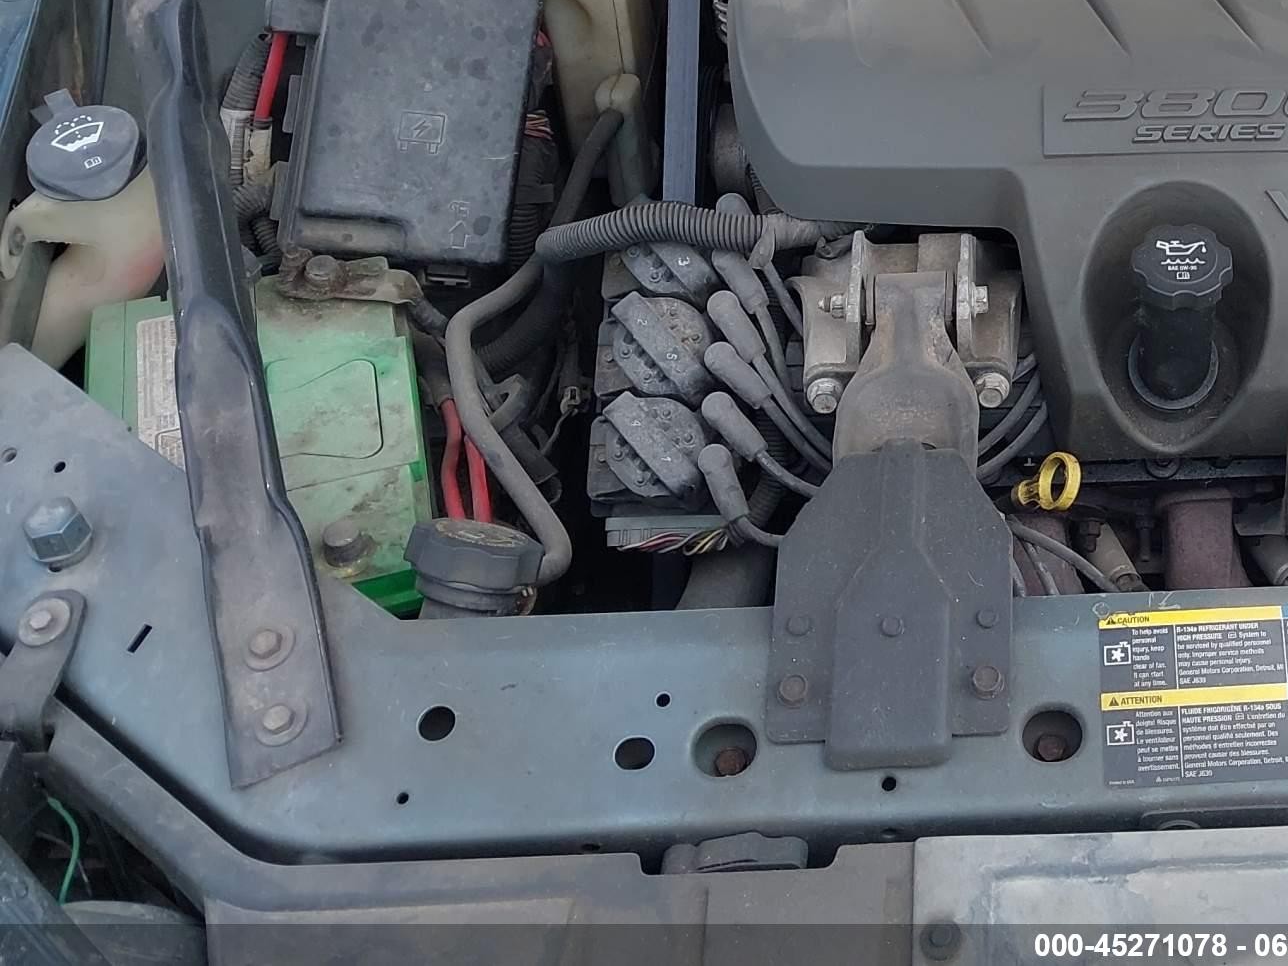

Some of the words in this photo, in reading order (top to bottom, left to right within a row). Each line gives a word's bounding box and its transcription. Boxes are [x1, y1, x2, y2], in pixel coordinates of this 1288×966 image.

[1132, 123, 1286, 143] SERIES
[1117, 616, 1150, 624] CAUTION
[1121, 695, 1162, 705] ATTENTION
